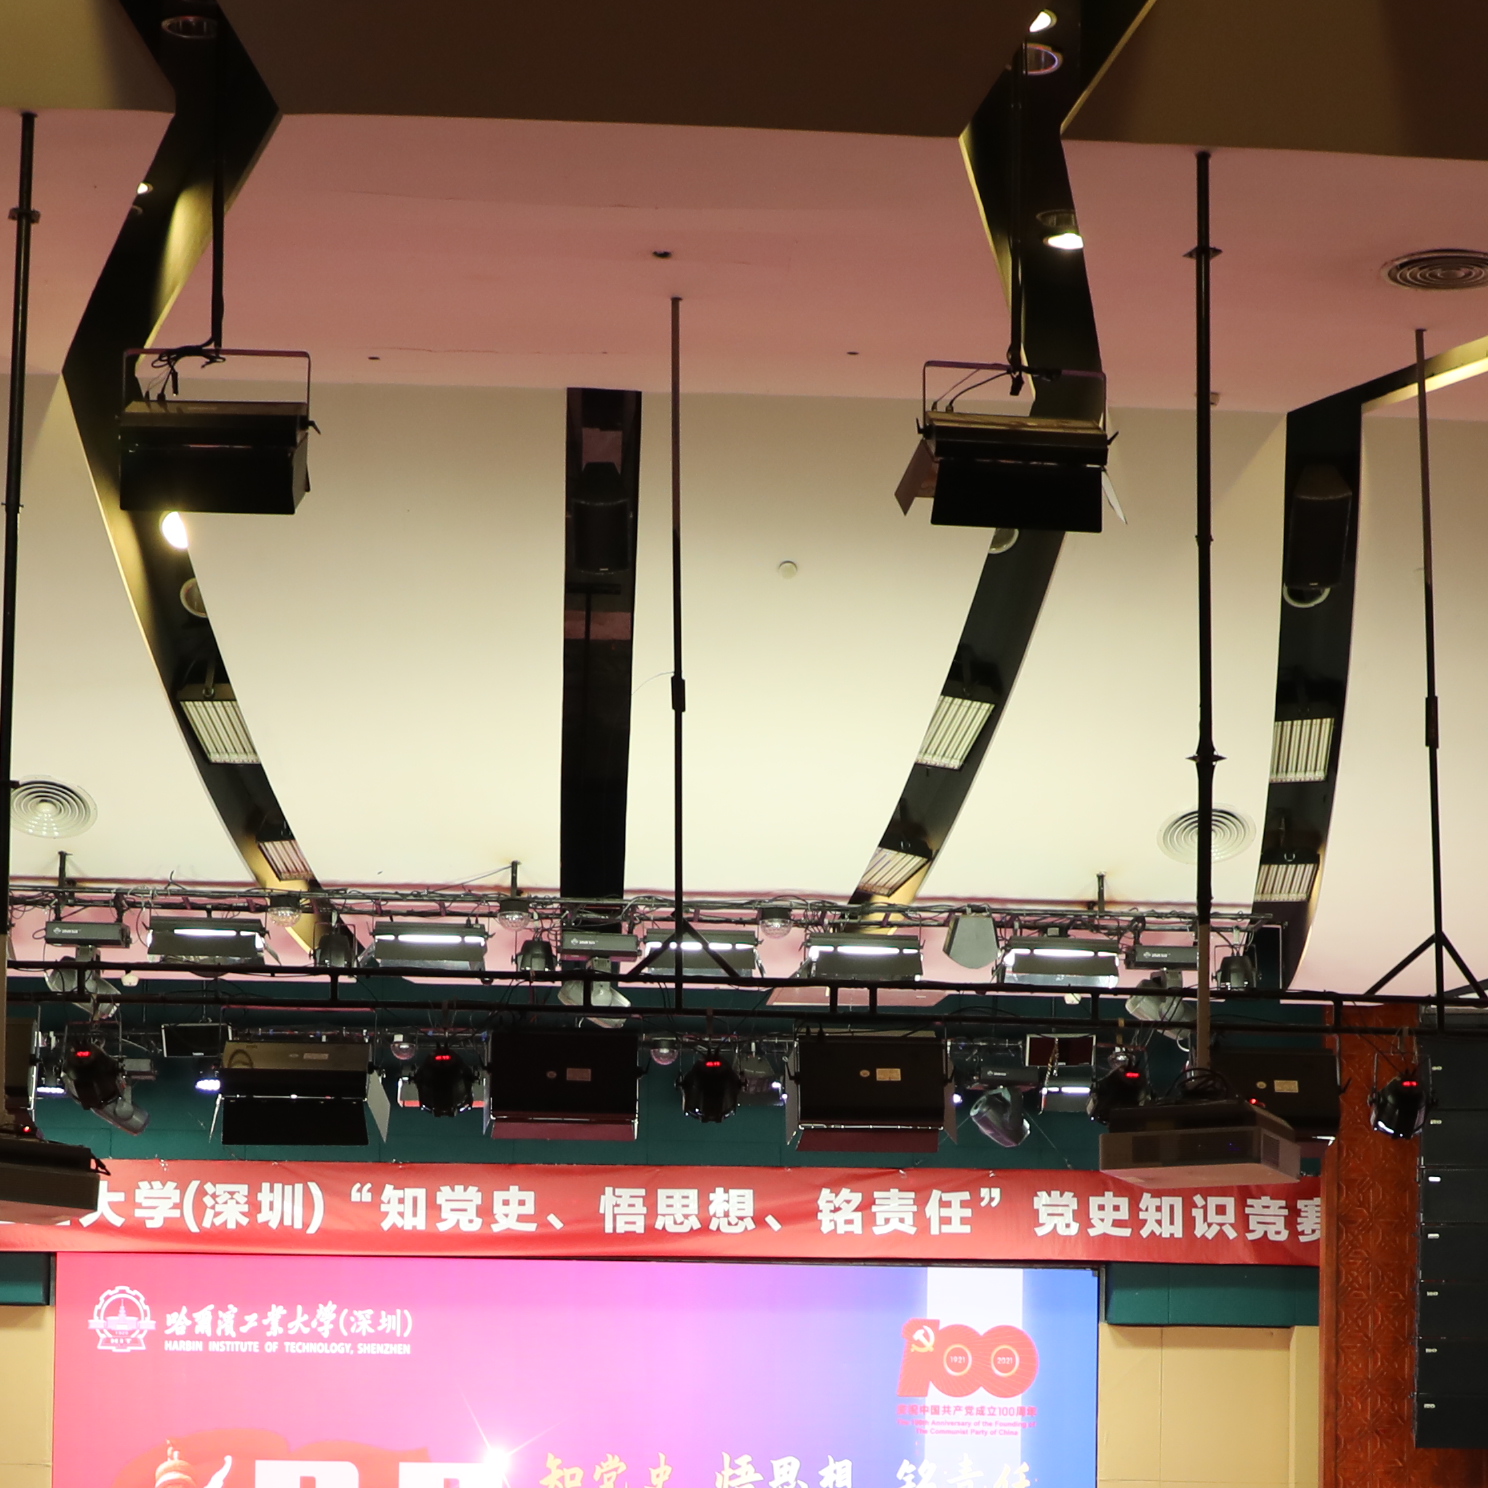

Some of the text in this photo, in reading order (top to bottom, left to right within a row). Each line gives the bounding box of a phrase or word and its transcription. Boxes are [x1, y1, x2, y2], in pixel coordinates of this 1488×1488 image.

[1033, 1190, 1321, 1243] 党史知识竞赛
[164, 1340, 411, 1355] HARBIN INSTITUTE OF TECHNOLOGY, SHENZHEN
